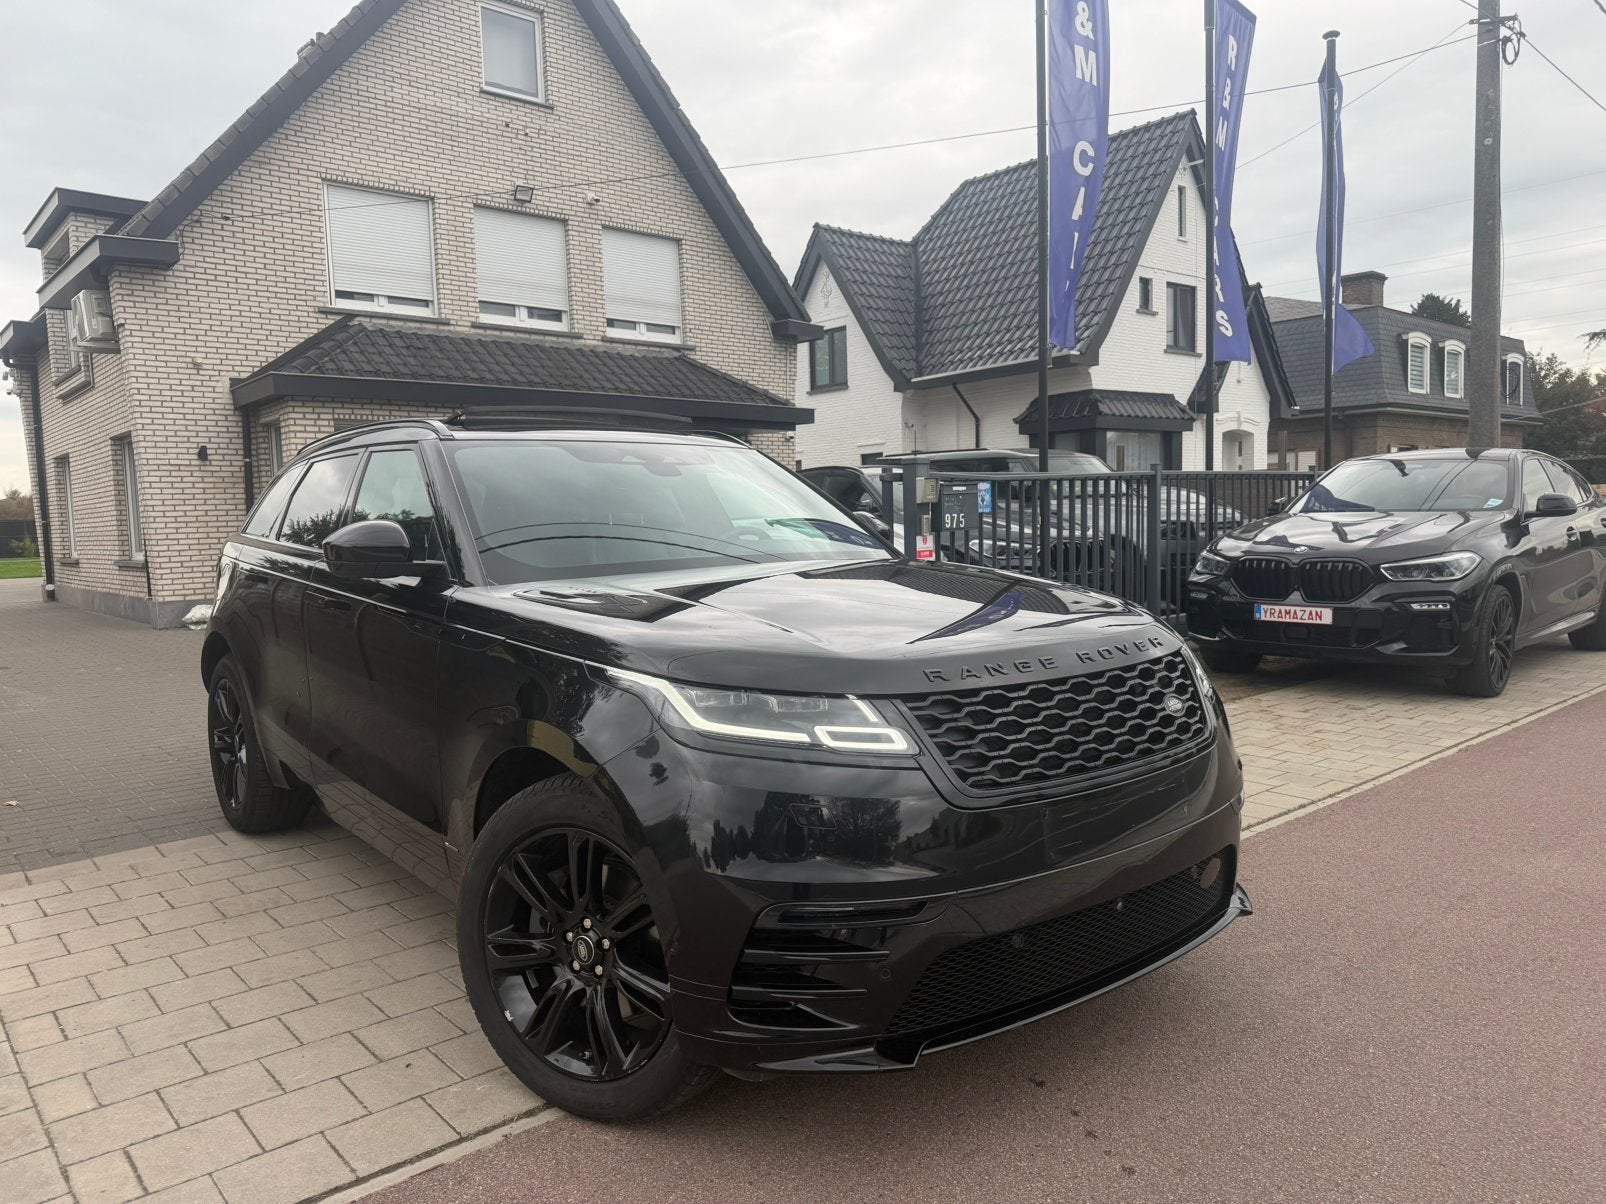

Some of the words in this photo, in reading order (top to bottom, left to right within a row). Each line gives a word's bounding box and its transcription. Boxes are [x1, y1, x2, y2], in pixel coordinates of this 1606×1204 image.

[944, 513, 965, 528] 975
[1262, 607, 1323, 622] YRAMAZAN
[922, 656, 1059, 682] RANGE
[1076, 636, 1165, 663] ROVER
